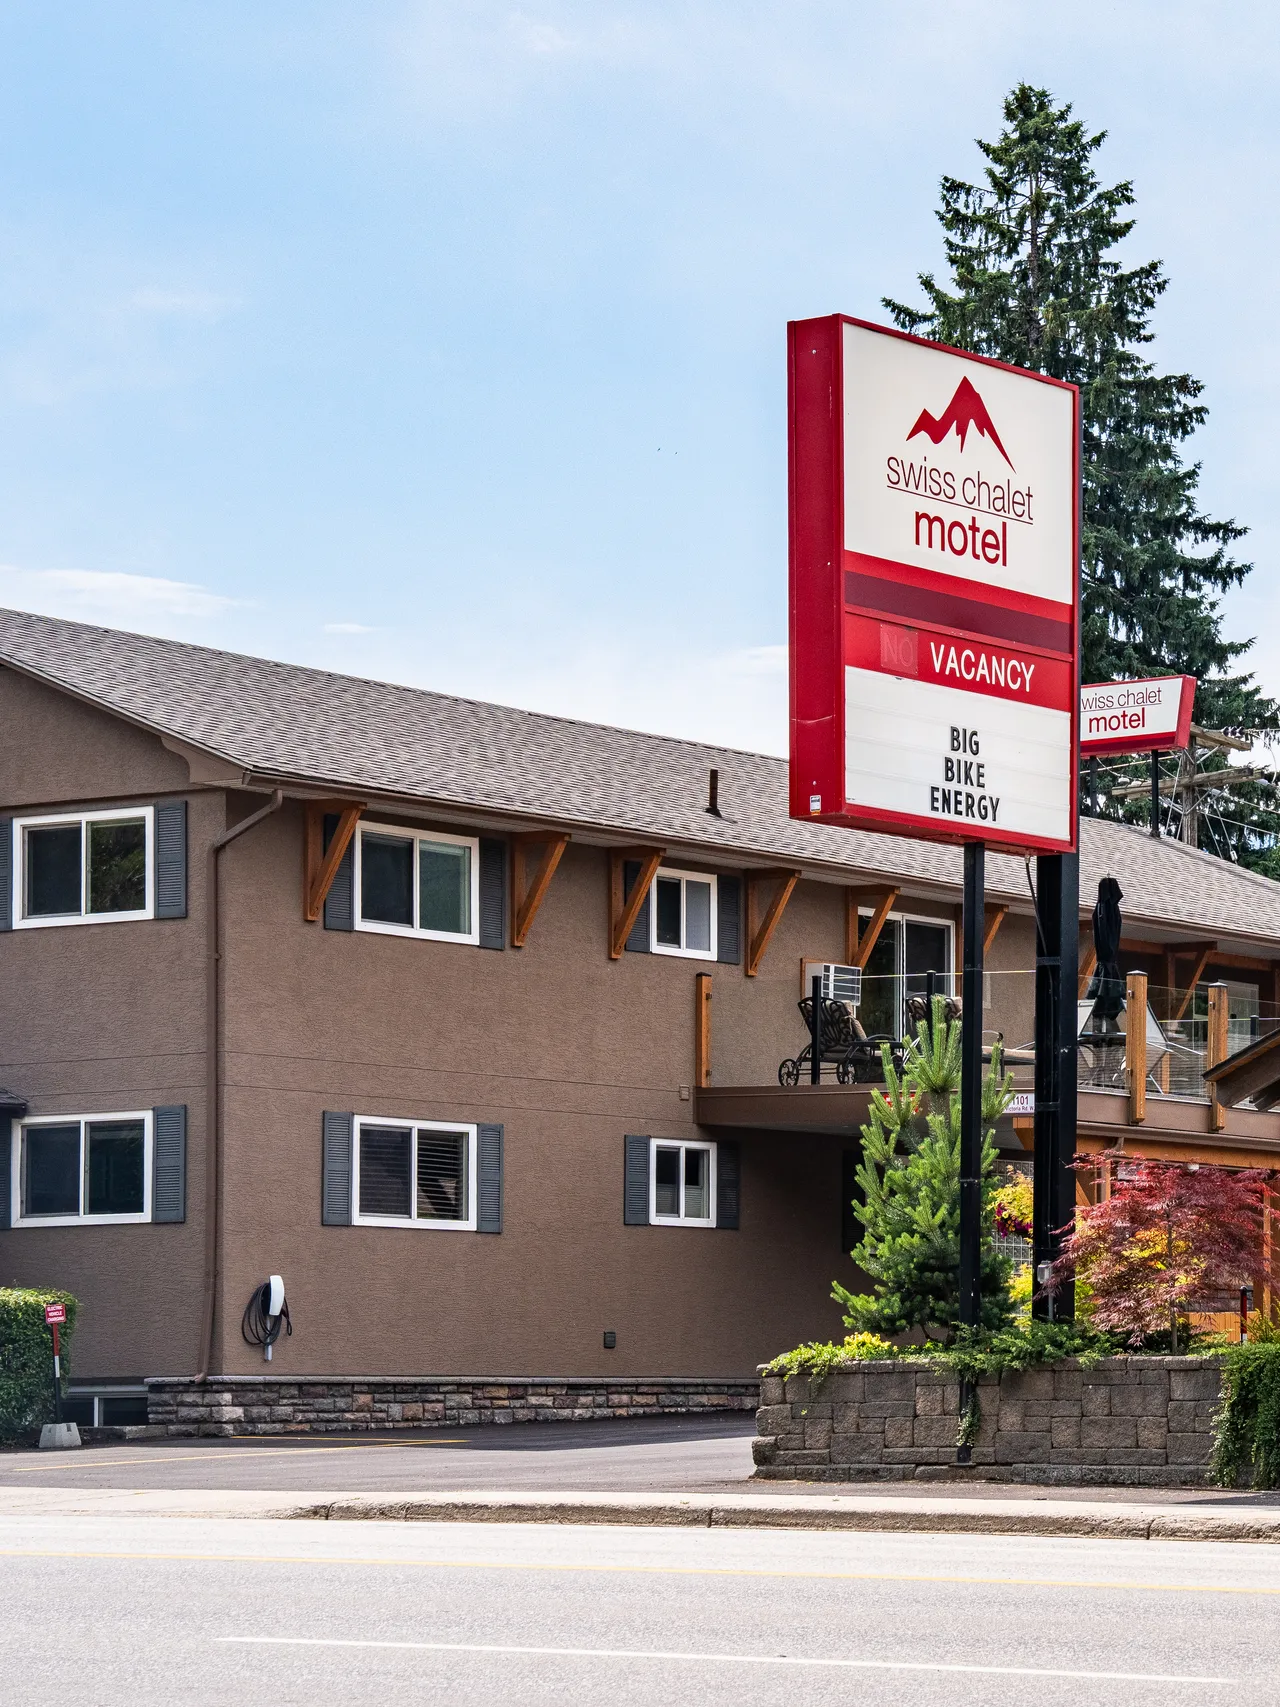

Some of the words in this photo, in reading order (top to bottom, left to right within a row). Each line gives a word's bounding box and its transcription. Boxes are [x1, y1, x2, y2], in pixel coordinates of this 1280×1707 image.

[887, 456, 956, 500] swiss
[962, 470, 1033, 520] chalet
[915, 510, 1007, 567] motel
[930, 641, 1035, 692] VACANCY
[1081, 693, 1114, 710] wiss
[1118, 687, 1162, 706] chalet
[1089, 707, 1145, 733] motel
[950, 726, 980, 756] BIG
[944, 757, 986, 788] BIKE
[930, 786, 1000, 822] ENERGY
